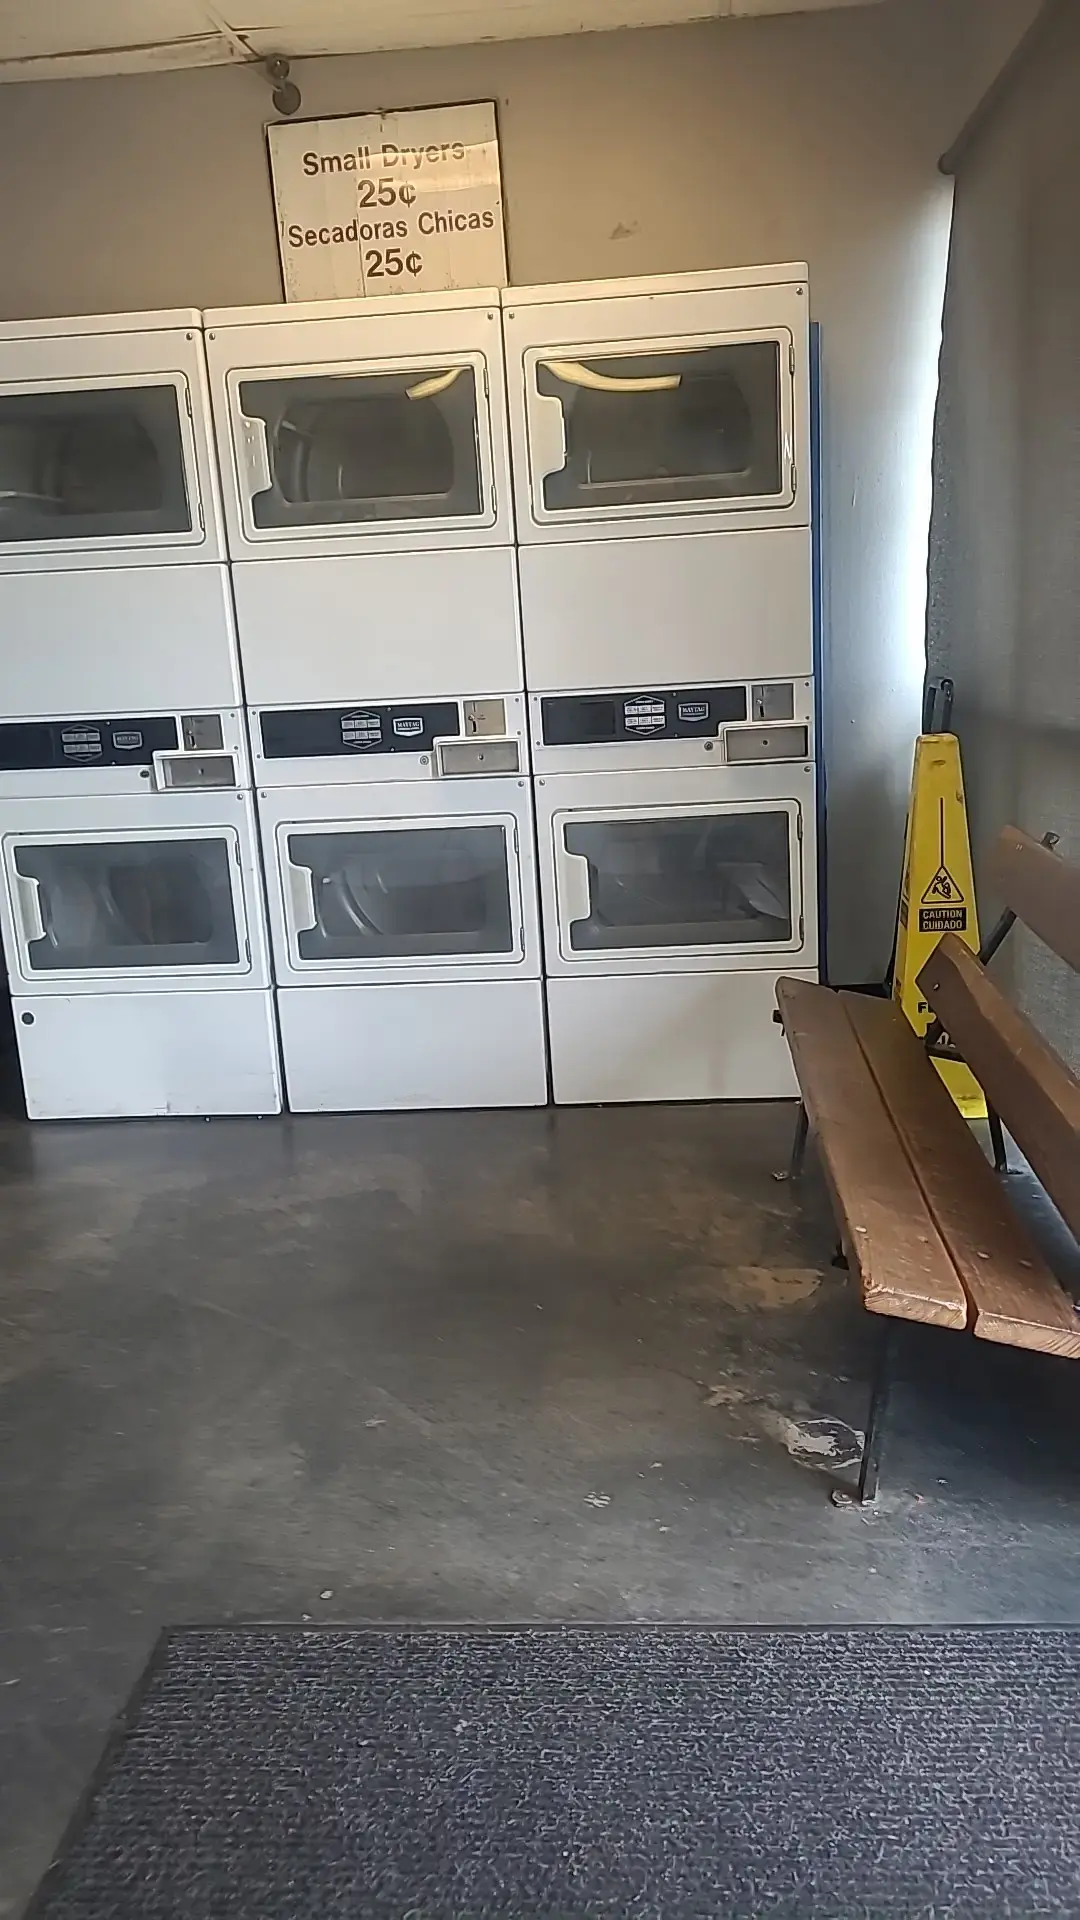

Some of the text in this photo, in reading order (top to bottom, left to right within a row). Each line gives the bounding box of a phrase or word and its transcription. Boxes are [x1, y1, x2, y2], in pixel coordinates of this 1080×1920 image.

[302, 141, 465, 176] Small Dryers
[357, 177, 417, 208] 25¢
[288, 209, 494, 248] Secadoras Chicas
[365, 247, 423, 278] 25¢
[922, 910, 963, 919] CAUTION
[922, 920, 963, 930] CUIDADO
